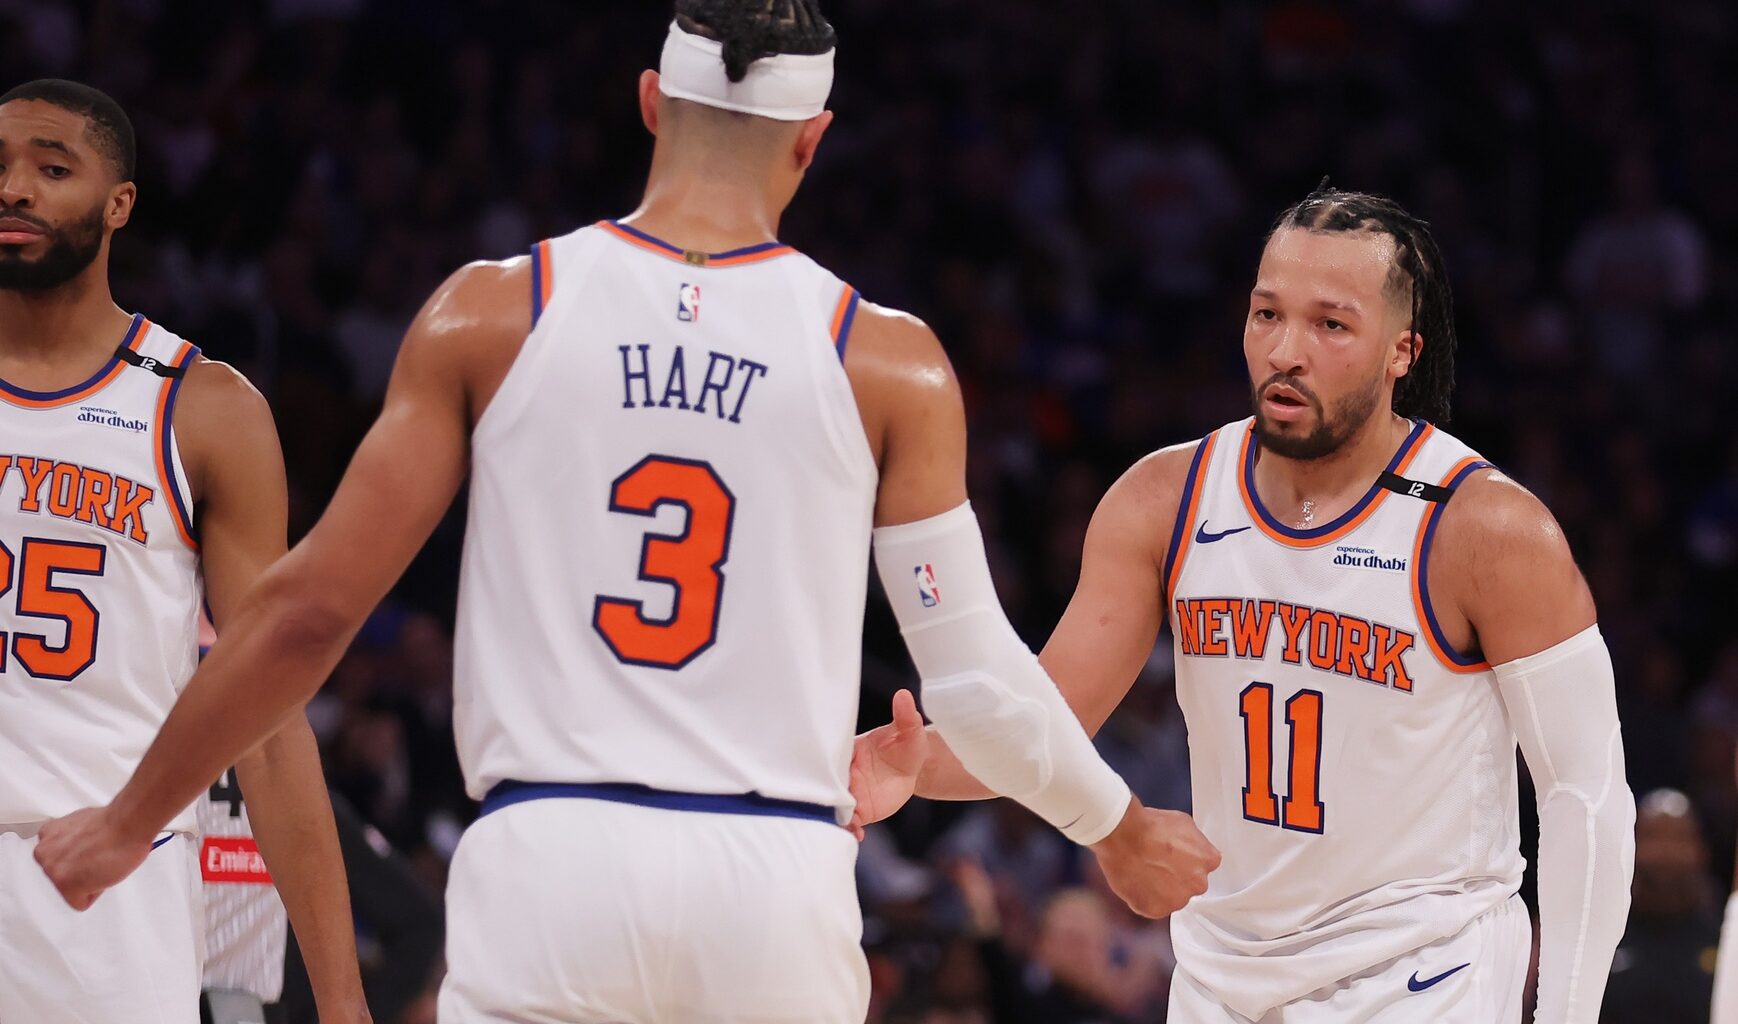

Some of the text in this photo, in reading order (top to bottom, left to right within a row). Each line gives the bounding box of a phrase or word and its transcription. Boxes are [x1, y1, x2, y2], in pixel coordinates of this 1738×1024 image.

[140, 357, 157, 371] 12
[618, 344, 768, 424] HART
[77, 412, 149, 432] abu dhabi
[79, 406, 118, 415] experience
[16, 455, 155, 546] YORK
[1407, 482, 1425, 497] 12
[591, 453, 736, 671] 3
[1333, 553, 1407, 571] abu dhabi
[1336, 546, 1375, 555] experience
[0, 537, 106, 681] 5
[1176, 599, 1415, 692] NEW YORK
[1239, 681, 1324, 834] 11
